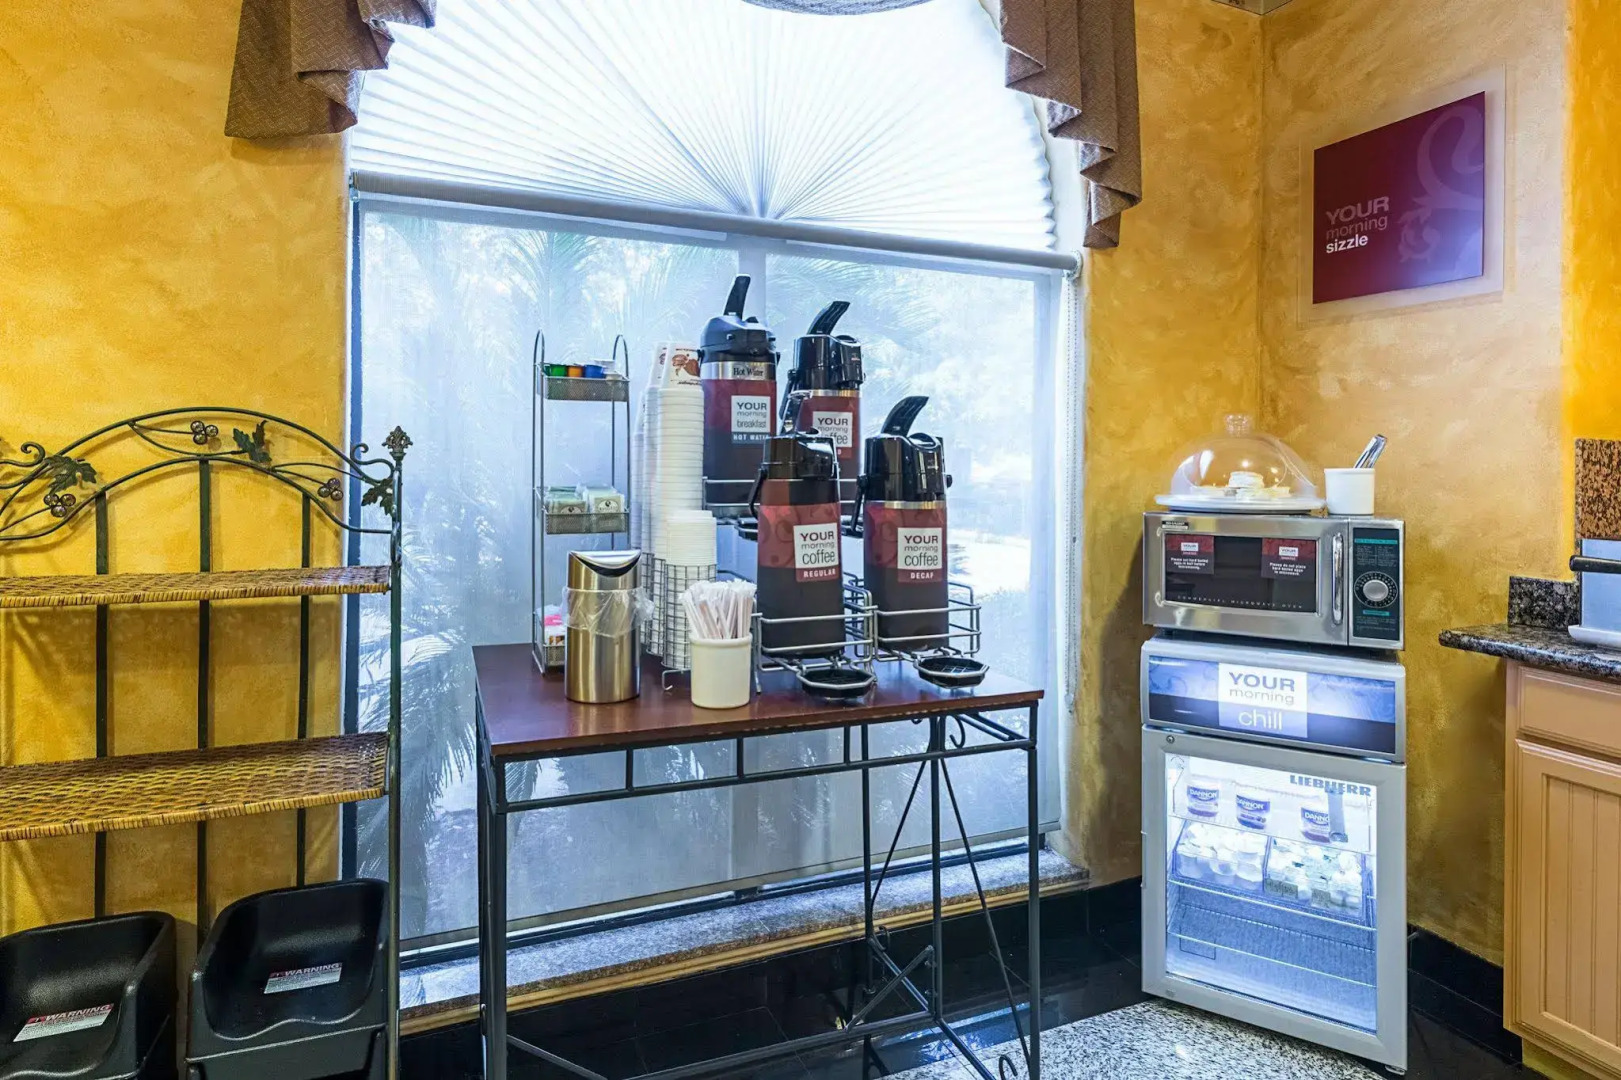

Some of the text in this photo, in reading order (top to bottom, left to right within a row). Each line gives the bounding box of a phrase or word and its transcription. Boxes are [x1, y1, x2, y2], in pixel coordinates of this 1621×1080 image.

[1325, 196, 1390, 225] YOUR
[1325, 216, 1388, 239] morning
[1326, 234, 1368, 254] sizzle
[733, 368, 763, 377] Hot Water
[736, 402, 767, 410] YOUR
[736, 420, 766, 428] breakfast
[817, 417, 849, 426] YOUR
[818, 426, 848, 434] morning
[800, 531, 835, 542] YOUR
[904, 535, 939, 544] YOUR
[801, 541, 835, 550] morning
[904, 545, 938, 553] morning
[802, 550, 836, 565] coffee
[904, 553, 938, 567] coffee
[803, 570, 836, 578] REGULAR
[1229, 672, 1295, 692] YOUR
[1230, 688, 1295, 706] morning
[1239, 709, 1283, 730] chill
[285, 963, 340, 976] WARNING
[46, 1004, 109, 1020] WARNING
